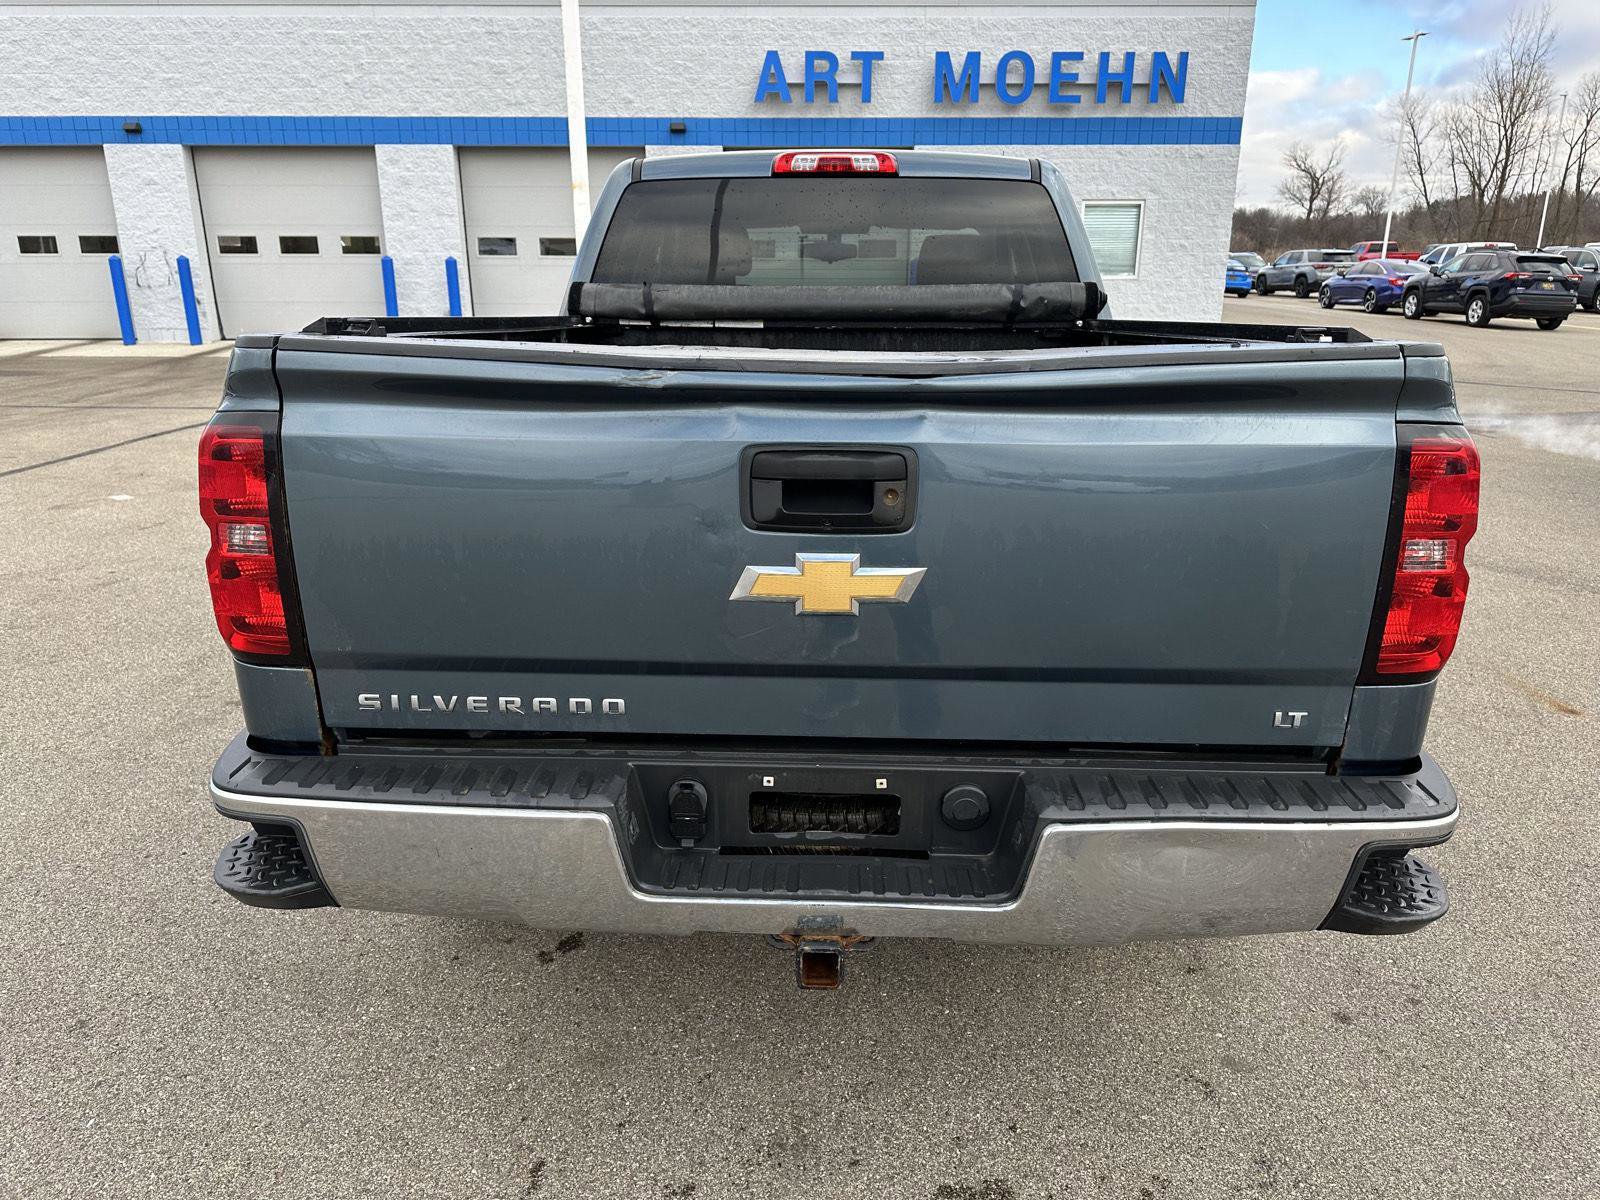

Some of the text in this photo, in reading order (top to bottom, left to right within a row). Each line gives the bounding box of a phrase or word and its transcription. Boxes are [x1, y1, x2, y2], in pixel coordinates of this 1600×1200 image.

[755, 50, 1190, 105] ART MOEHN
[357, 693, 627, 715] SILVERADO
[1273, 711, 1309, 728] LT
